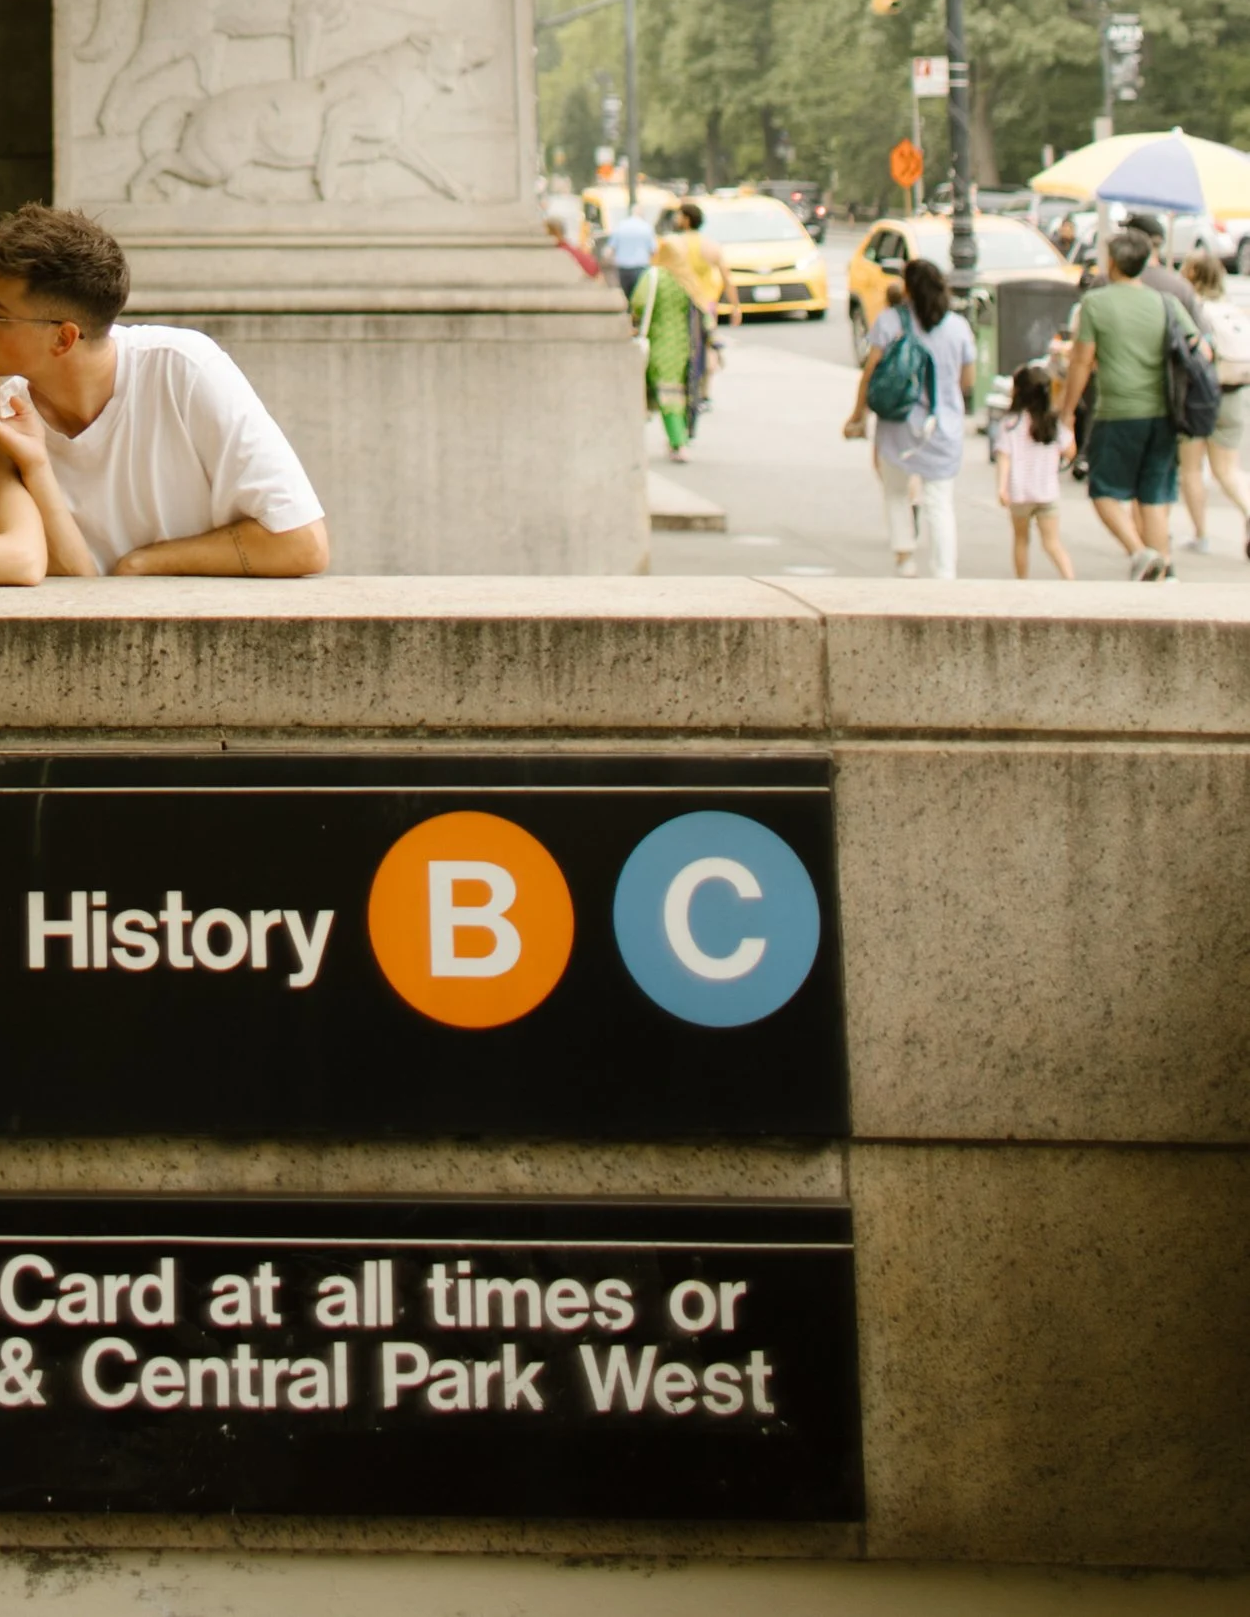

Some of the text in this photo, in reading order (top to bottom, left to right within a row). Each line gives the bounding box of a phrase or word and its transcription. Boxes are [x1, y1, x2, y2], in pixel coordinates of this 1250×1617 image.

[27, 889, 335, 989] History
[427, 856, 768, 981] B C
[208, 1260, 283, 1327] at
[315, 1258, 395, 1329] all
[425, 1260, 636, 1332] times
[668, 1277, 748, 1333] or
[80, 1336, 349, 1410] Central
[381, 1340, 546, 1413] Park
[577, 1343, 776, 1417] West
